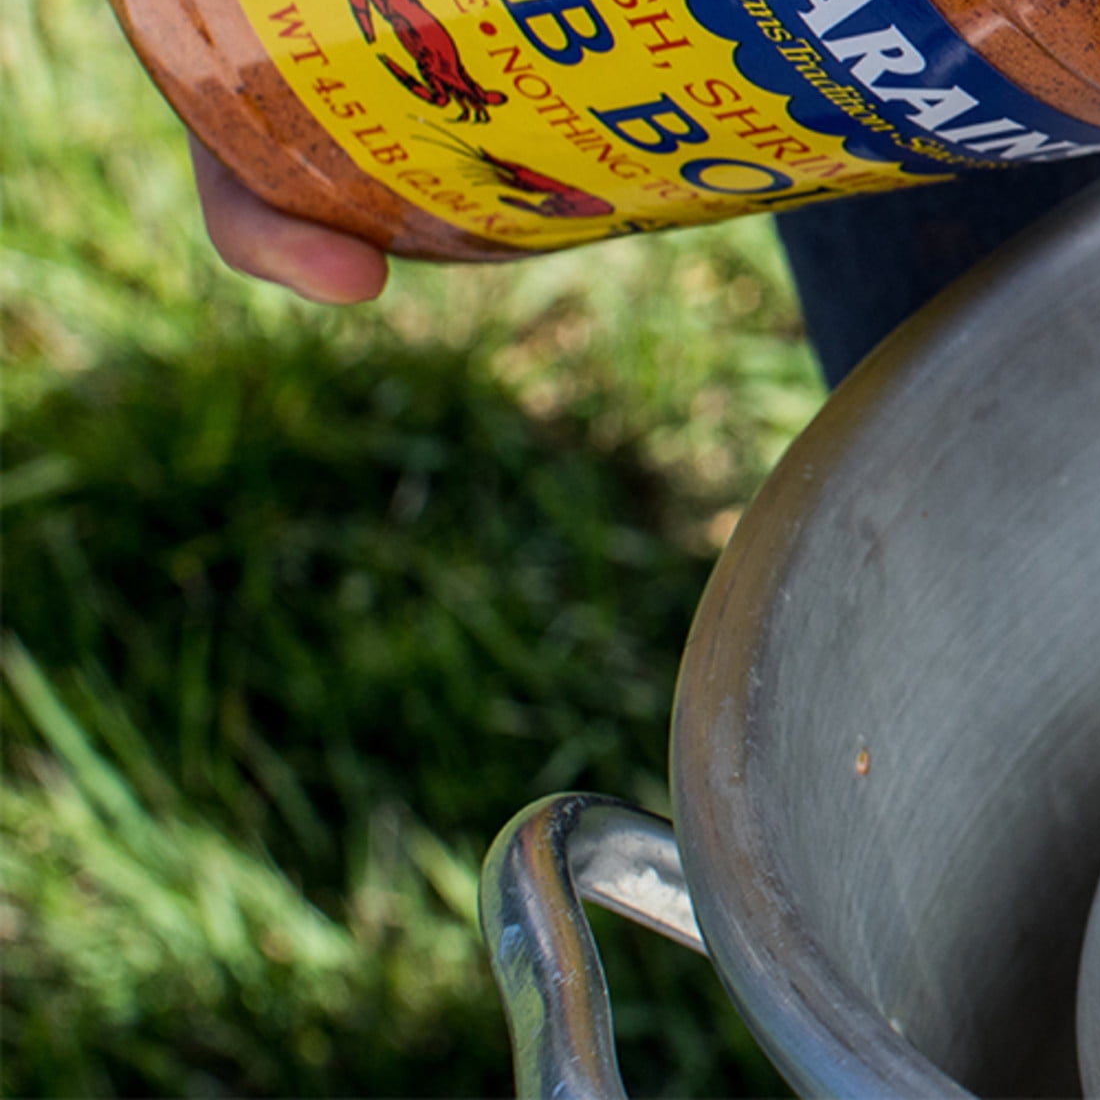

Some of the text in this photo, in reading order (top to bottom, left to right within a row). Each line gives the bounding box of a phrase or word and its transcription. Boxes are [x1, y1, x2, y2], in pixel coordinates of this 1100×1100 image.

[268, 2, 329, 68] WT
[311, 75, 367, 121] 4.5
[355, 124, 409, 177] LB
[489, 46, 651, 180] NOTHING
[777, 38, 895, 134] Tradition
[587, 93, 836, 206] BO
